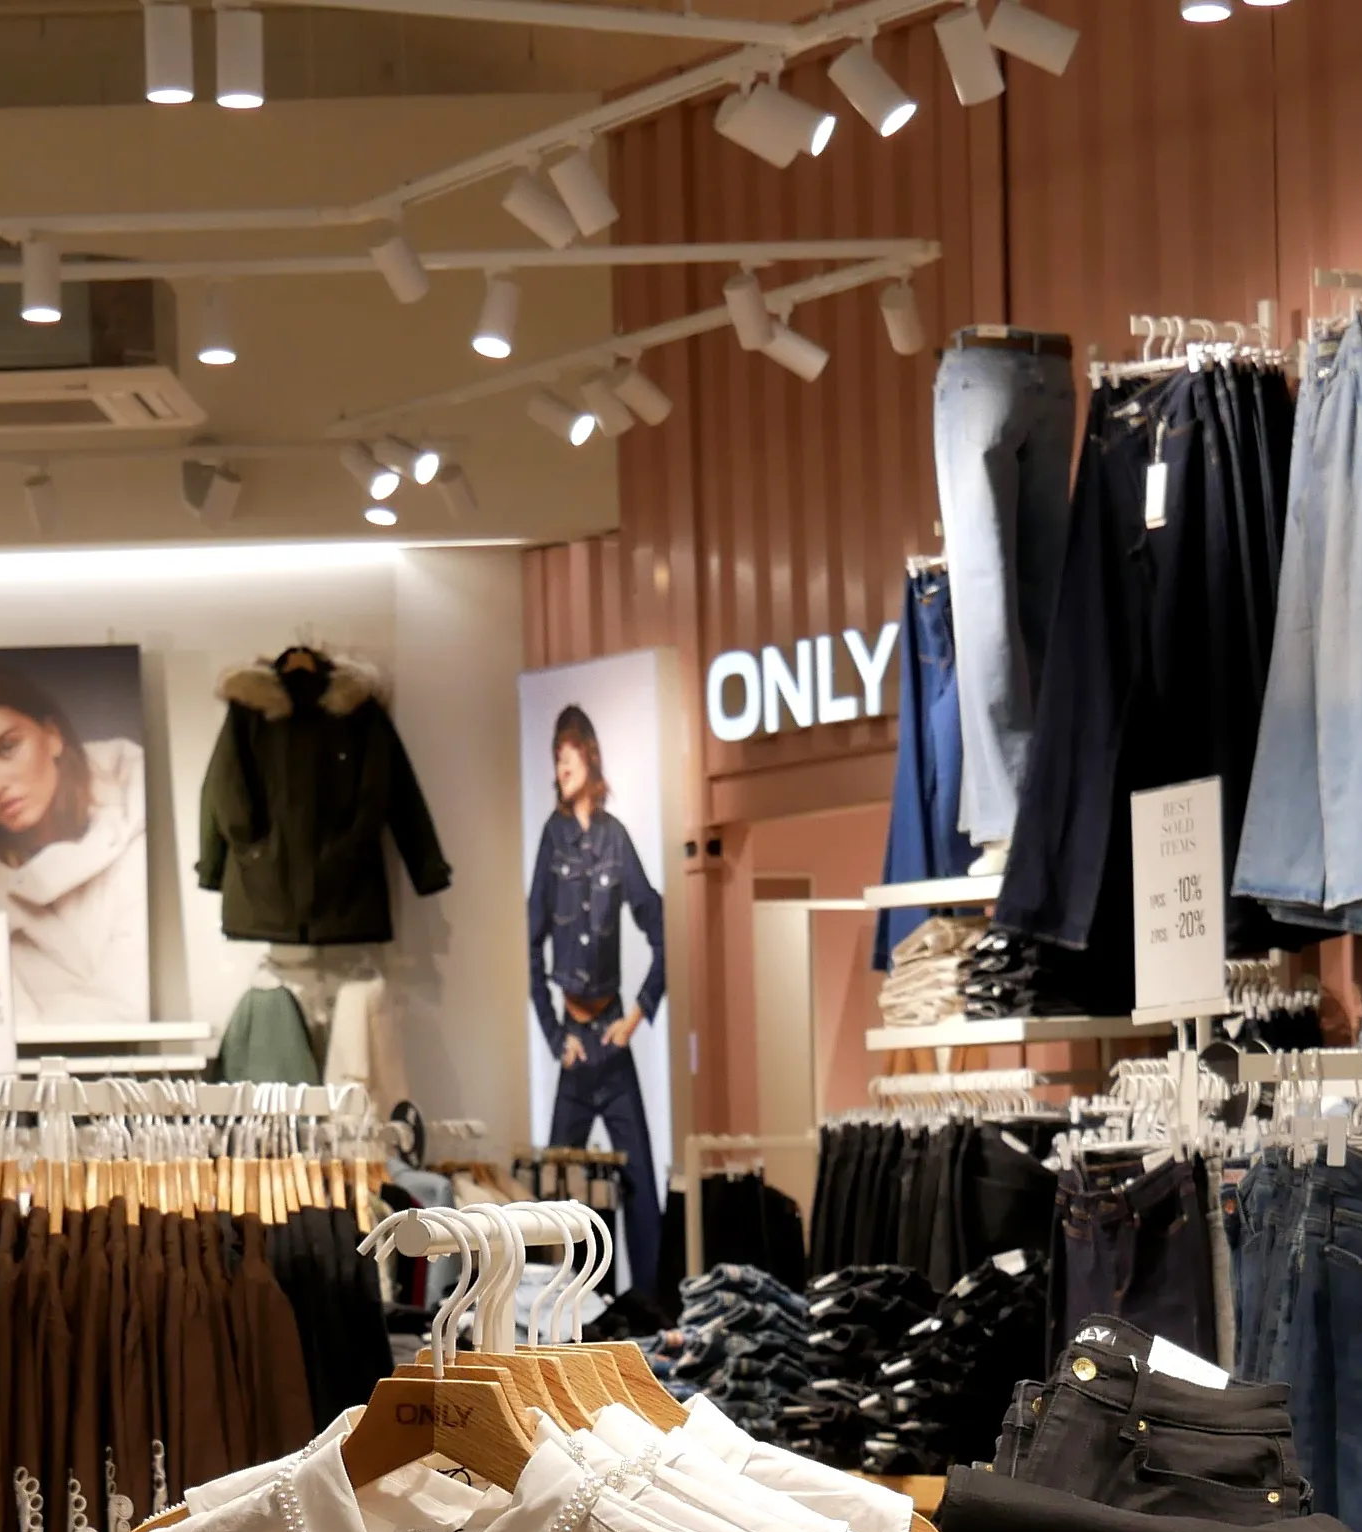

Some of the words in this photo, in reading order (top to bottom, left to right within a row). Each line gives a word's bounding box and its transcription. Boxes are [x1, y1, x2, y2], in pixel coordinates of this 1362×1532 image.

[706, 621, 900, 742] ONLY
[1162, 797, 1193, 818] BEST
[1161, 817, 1195, 837] SOLD
[1159, 837, 1197, 857] ITEMS
[395, 1403, 475, 1429] ONLY
